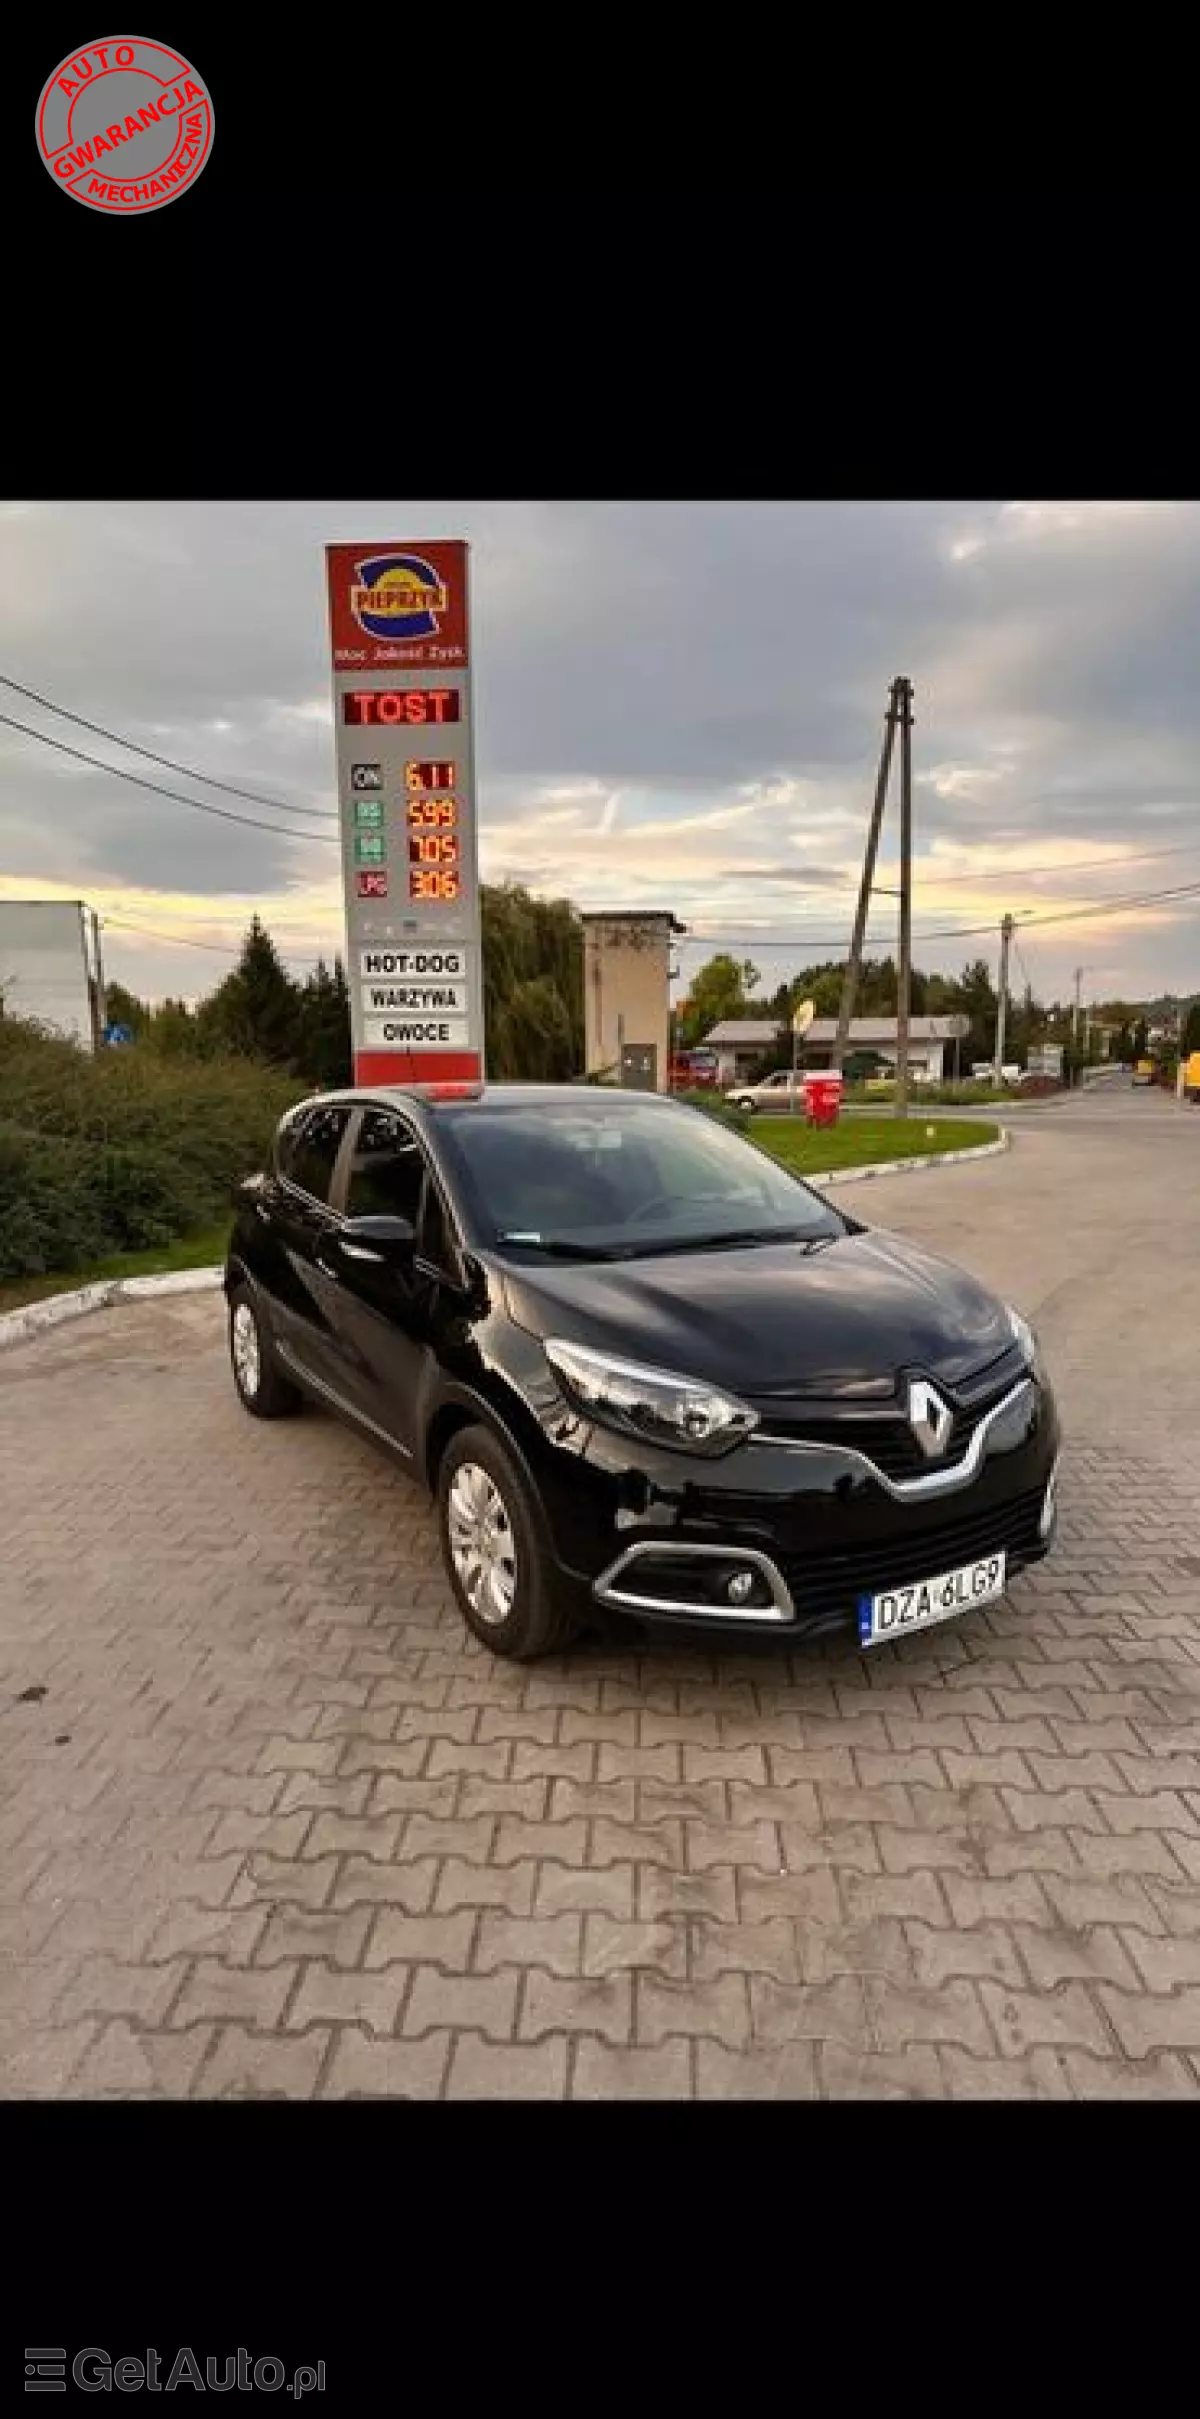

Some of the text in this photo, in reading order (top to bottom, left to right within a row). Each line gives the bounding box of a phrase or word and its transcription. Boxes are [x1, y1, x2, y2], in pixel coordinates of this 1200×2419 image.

[355, 589, 444, 609] PIEPRZYK
[353, 691, 450, 725] TOST
[364, 954, 460, 973] HOT-DOG
[371, 988, 458, 1008] WARZYWA
[383, 1023, 450, 1041] OWOCE
[877, 1560, 999, 1630] DZA 6LG9
